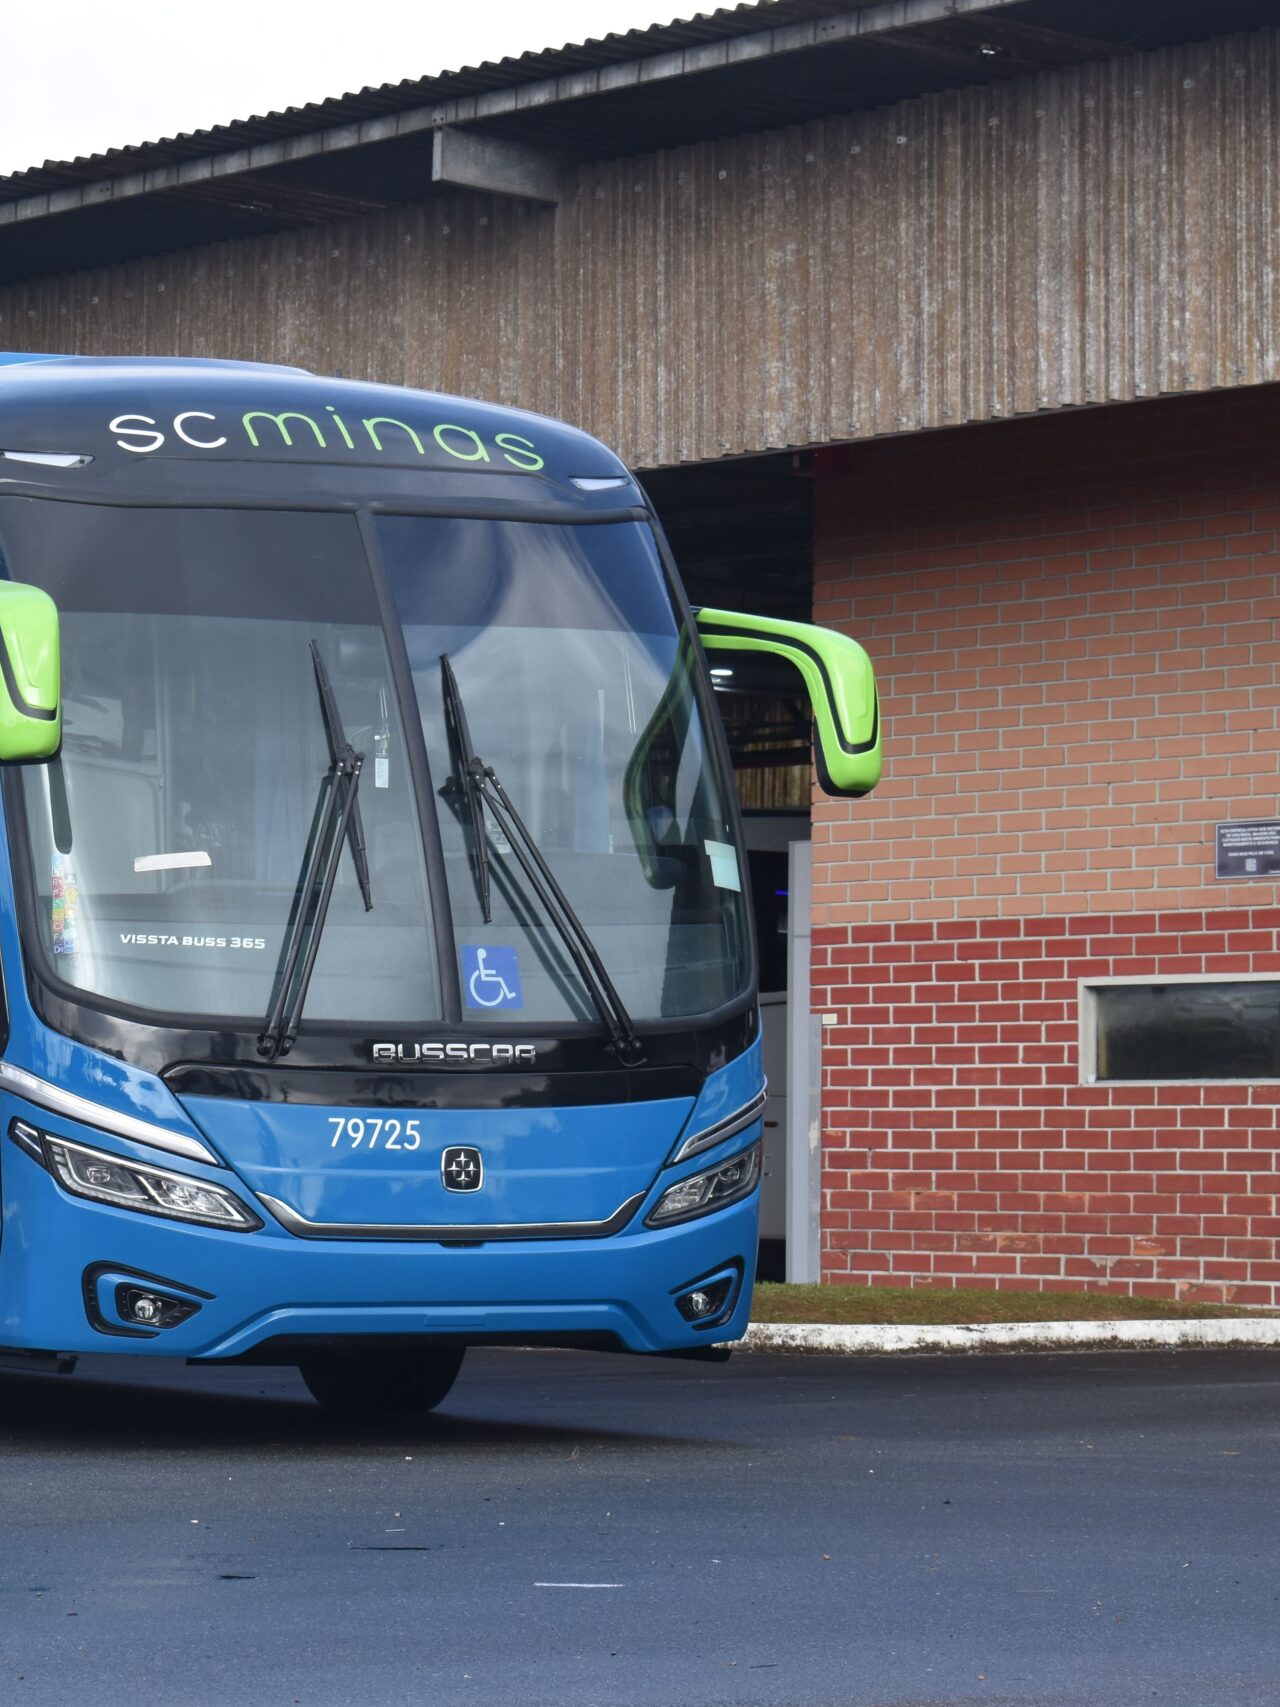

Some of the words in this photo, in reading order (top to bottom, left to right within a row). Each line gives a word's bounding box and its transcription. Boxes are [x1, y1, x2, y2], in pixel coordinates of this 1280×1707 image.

[119, 933, 180, 946] VISSTA
[181, 936, 227, 948] BUSS
[229, 937, 266, 950] 365
[372, 1042, 536, 1065] BUSSCAR
[327, 1117, 421, 1151] 79725
